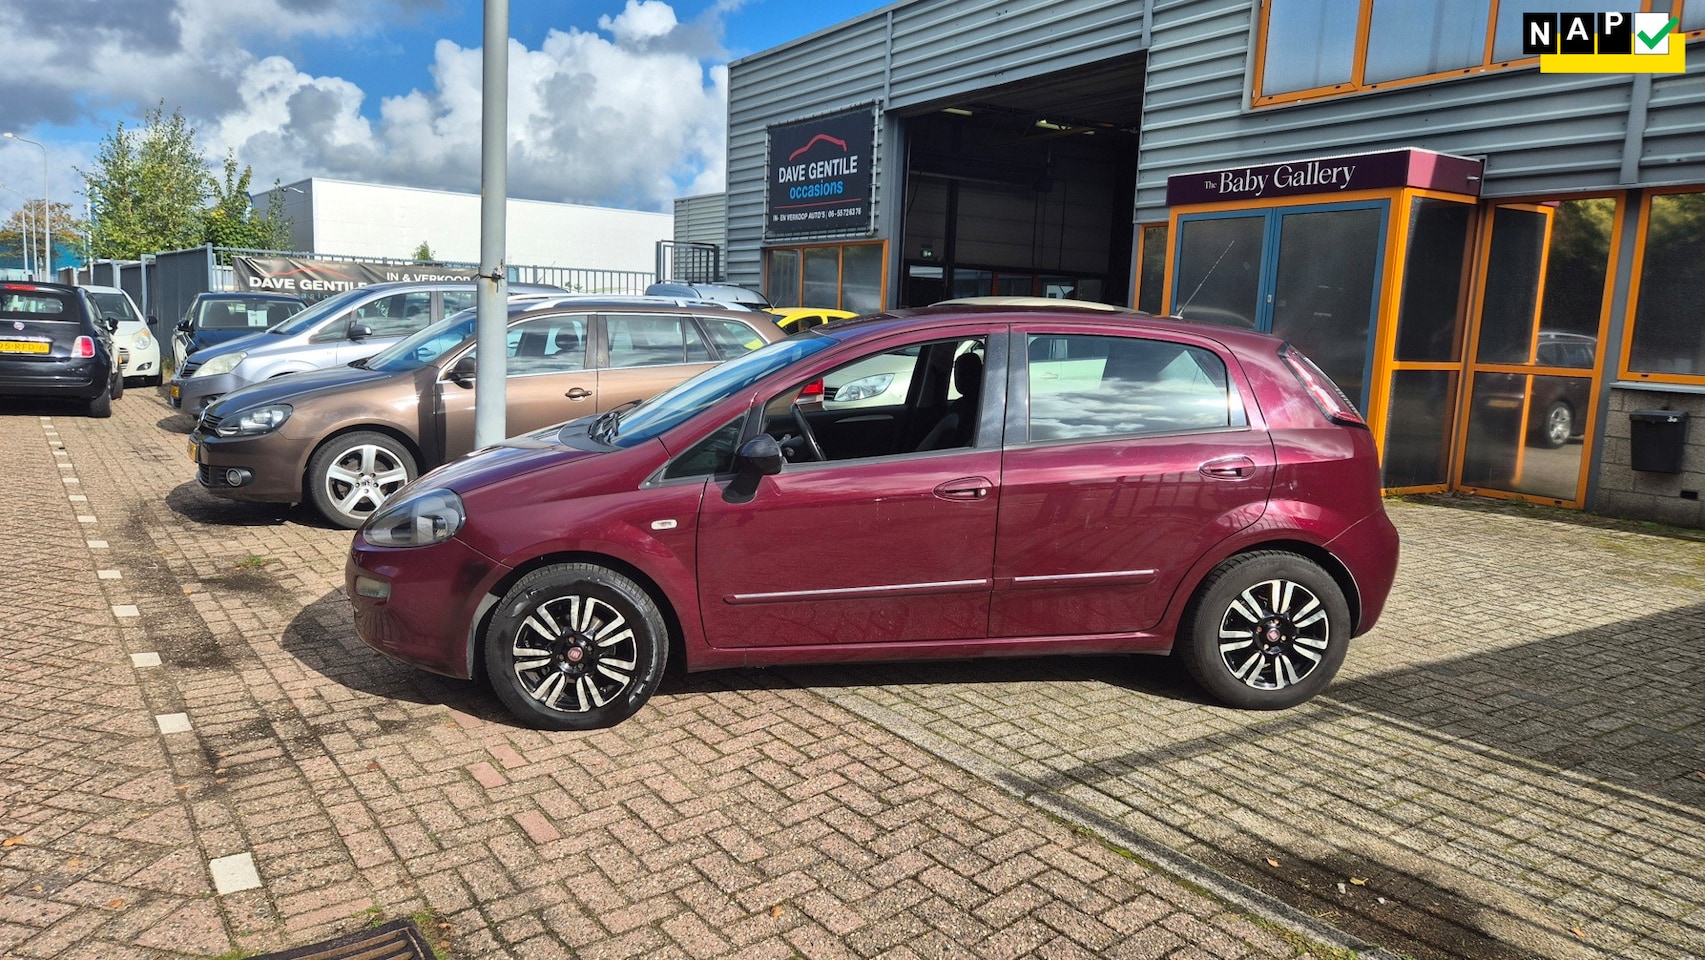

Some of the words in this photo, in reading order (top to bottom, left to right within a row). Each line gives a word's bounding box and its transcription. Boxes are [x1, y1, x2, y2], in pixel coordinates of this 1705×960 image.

[778, 164, 806, 183] DAVE
[809, 155, 858, 179] GENTILE
[1204, 180, 1217, 190] The
[1218, 169, 1269, 196] Baby
[1273, 161, 1356, 189] Gallery
[789, 180, 844, 199] occasions
[786, 212, 808, 221] VERKOOP
[249, 276, 295, 289] DAVE
[386, 272, 399, 281] IN
[402, 273, 411, 282] &
